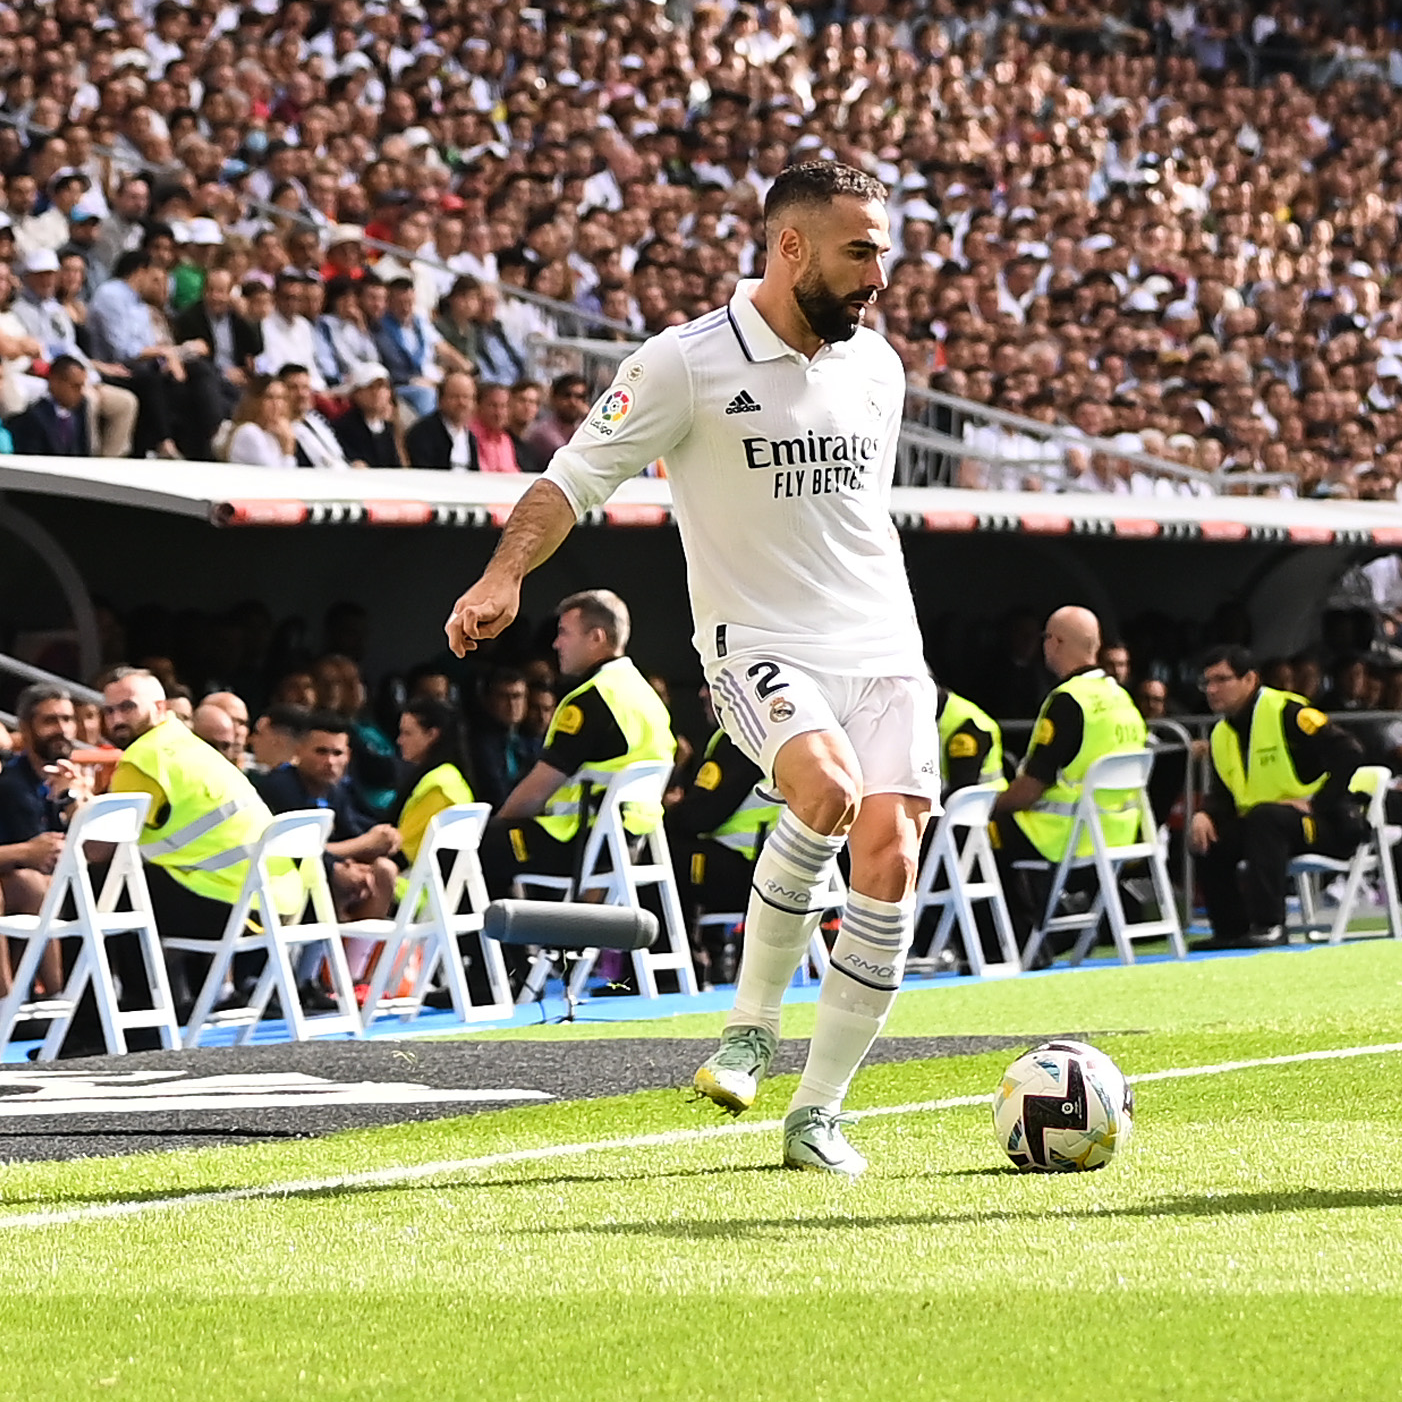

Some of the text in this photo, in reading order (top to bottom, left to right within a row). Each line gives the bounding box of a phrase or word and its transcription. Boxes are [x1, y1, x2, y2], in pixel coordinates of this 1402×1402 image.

[725, 403, 762, 415] adidas
[773, 470, 805, 499] FLY
[746, 661, 790, 703] 2
